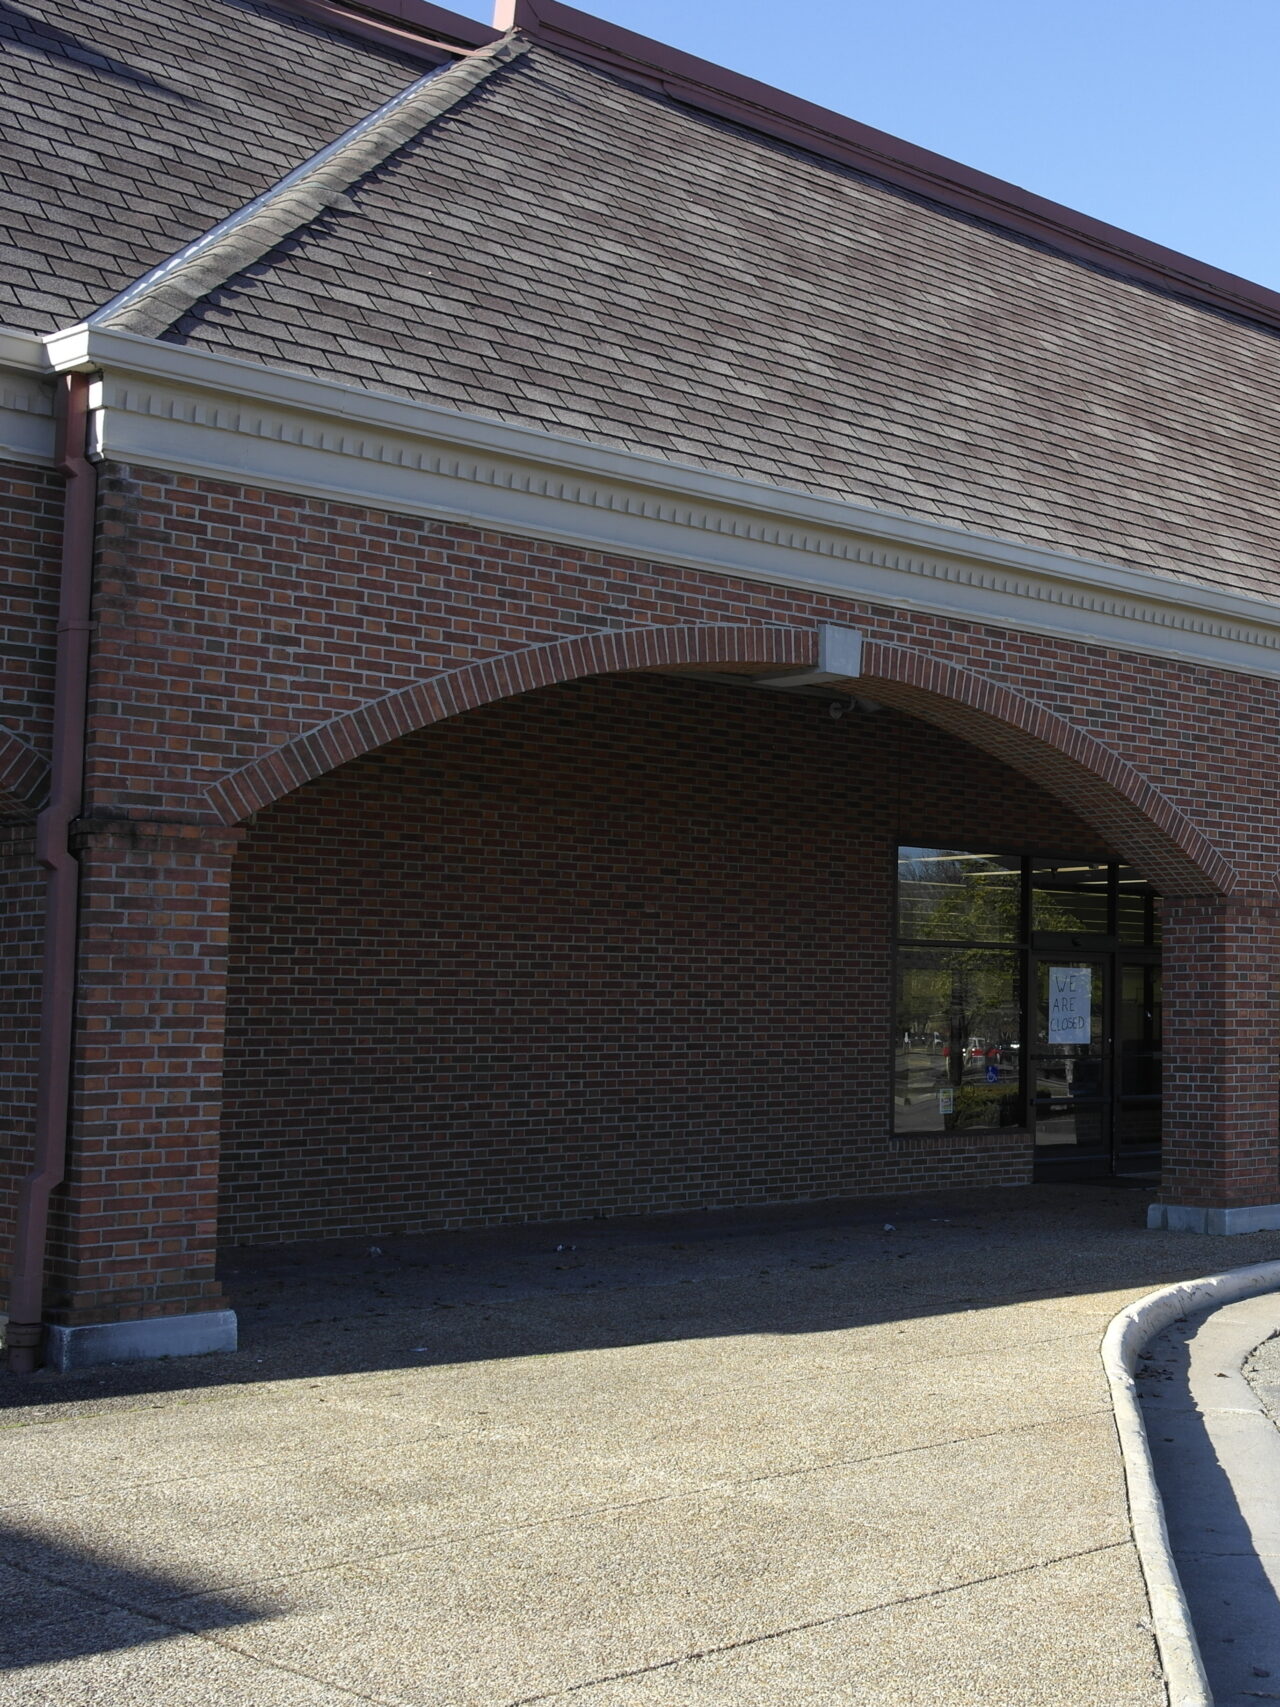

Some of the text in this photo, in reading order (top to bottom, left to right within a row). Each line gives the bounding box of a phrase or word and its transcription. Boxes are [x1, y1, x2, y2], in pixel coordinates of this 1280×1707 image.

[1055, 975, 1077, 993] WE
[1052, 997, 1077, 1013] ARE
[1050, 1016, 1085, 1032] CLOSED
